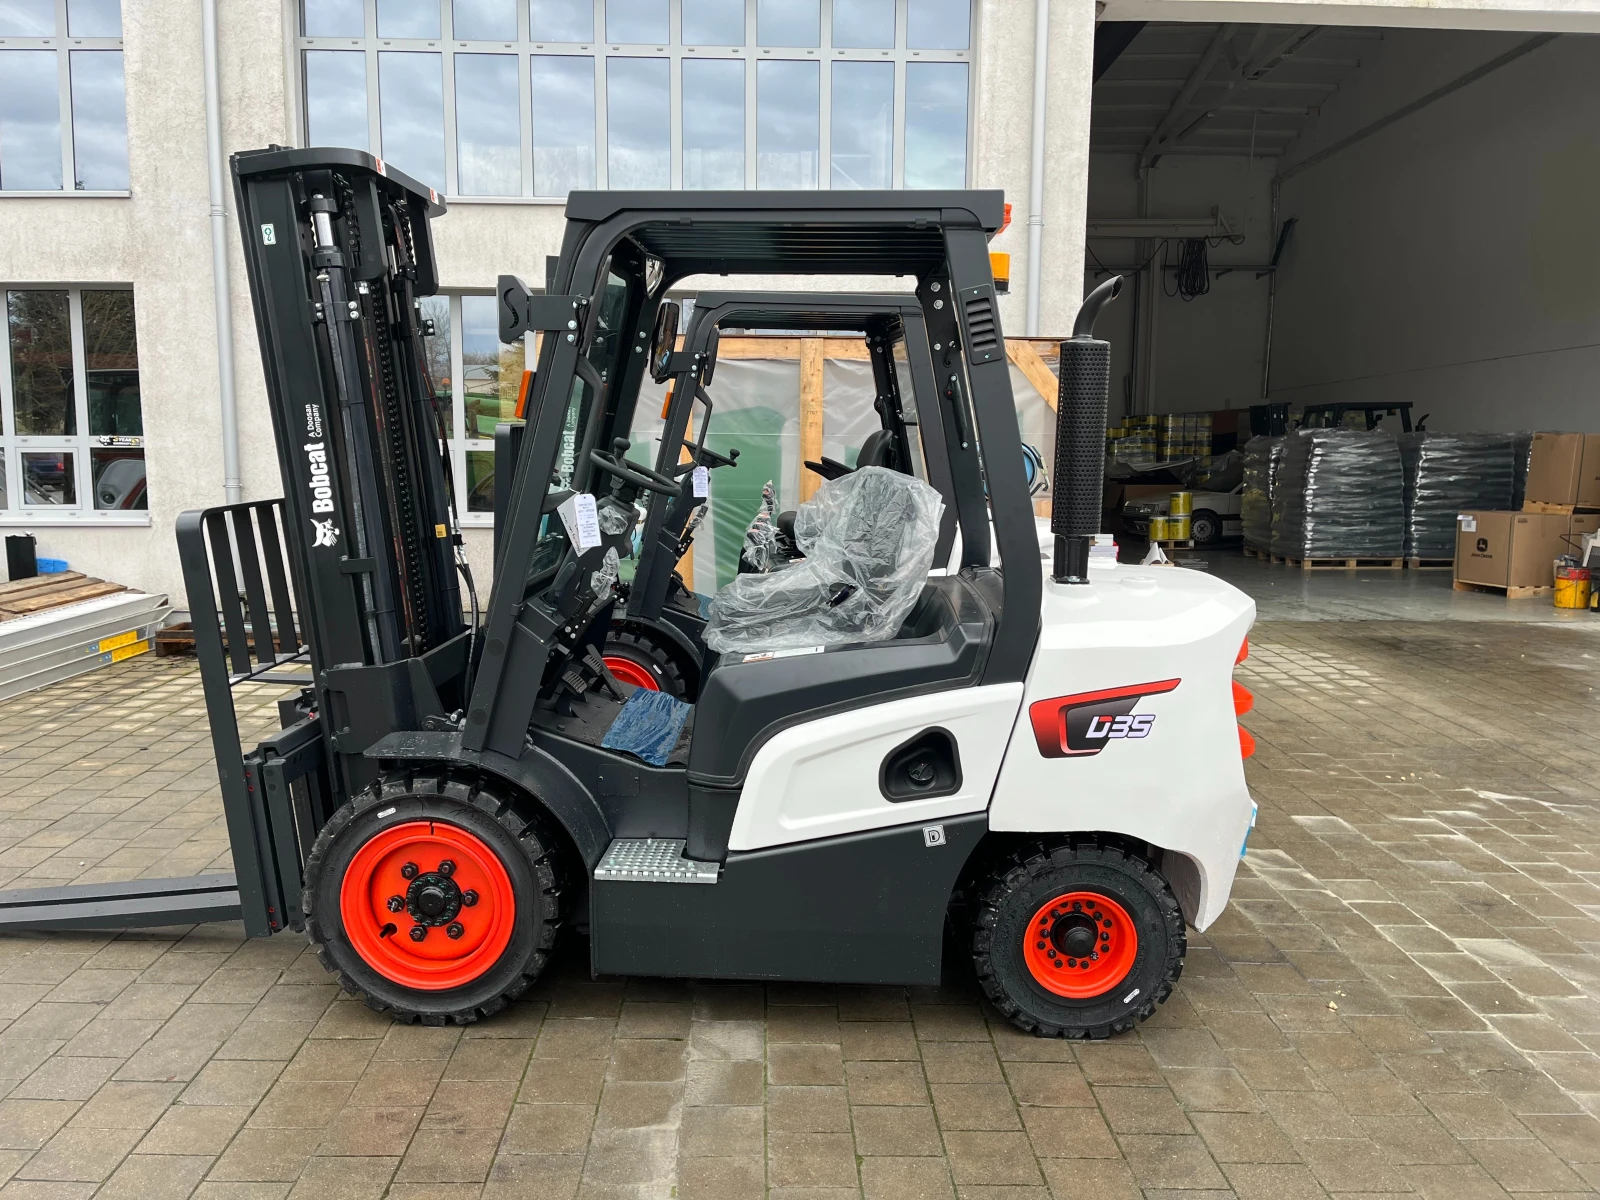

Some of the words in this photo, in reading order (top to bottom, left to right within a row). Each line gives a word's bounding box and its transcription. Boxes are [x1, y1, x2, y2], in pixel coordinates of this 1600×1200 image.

[305, 404, 315, 431] Doosan
[312, 403, 323, 438] Company
[561, 430, 575, 473] Bobcat
[303, 442, 335, 514] Bobcat
[1085, 715, 1156, 738] D35
